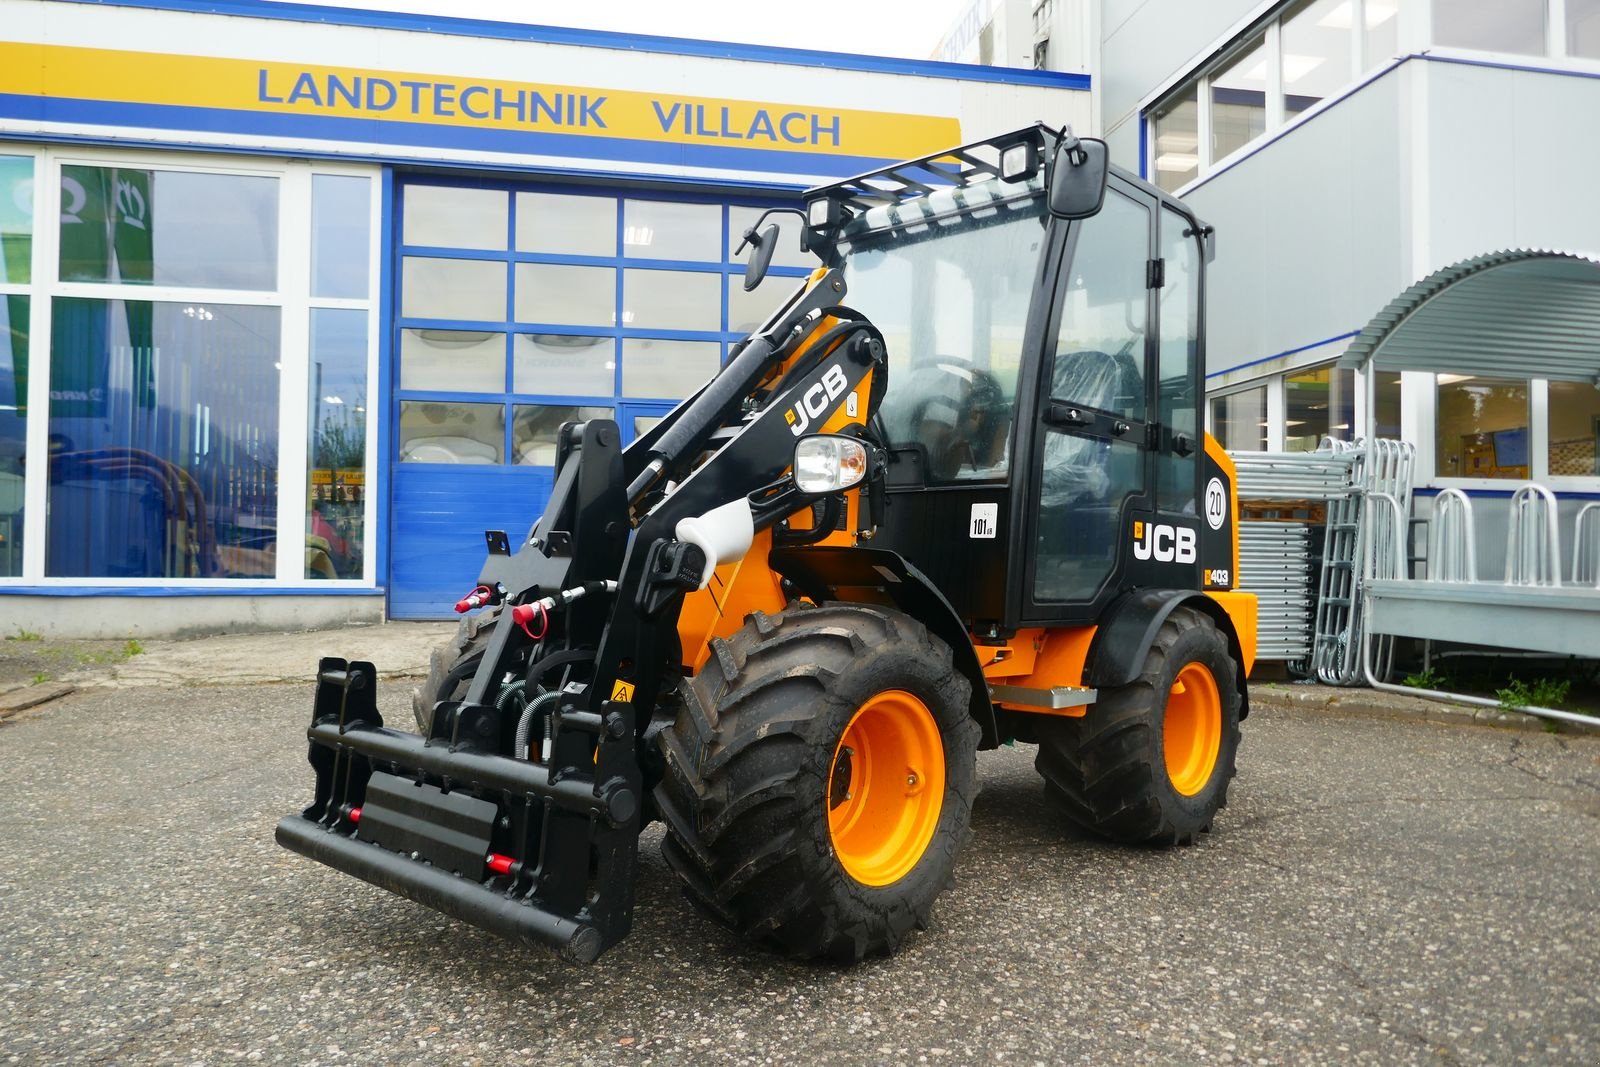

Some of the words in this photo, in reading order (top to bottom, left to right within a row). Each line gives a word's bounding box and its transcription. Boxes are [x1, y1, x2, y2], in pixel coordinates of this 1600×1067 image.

[258, 69, 607, 128] LANDTECHNIK
[651, 101, 840, 146] VILLACH
[790, 364, 848, 437] JCB
[1210, 490, 1221, 516] 20
[974, 519, 987, 535] 101
[1133, 522, 1196, 564] JCB
[1211, 569, 1229, 583] 403
